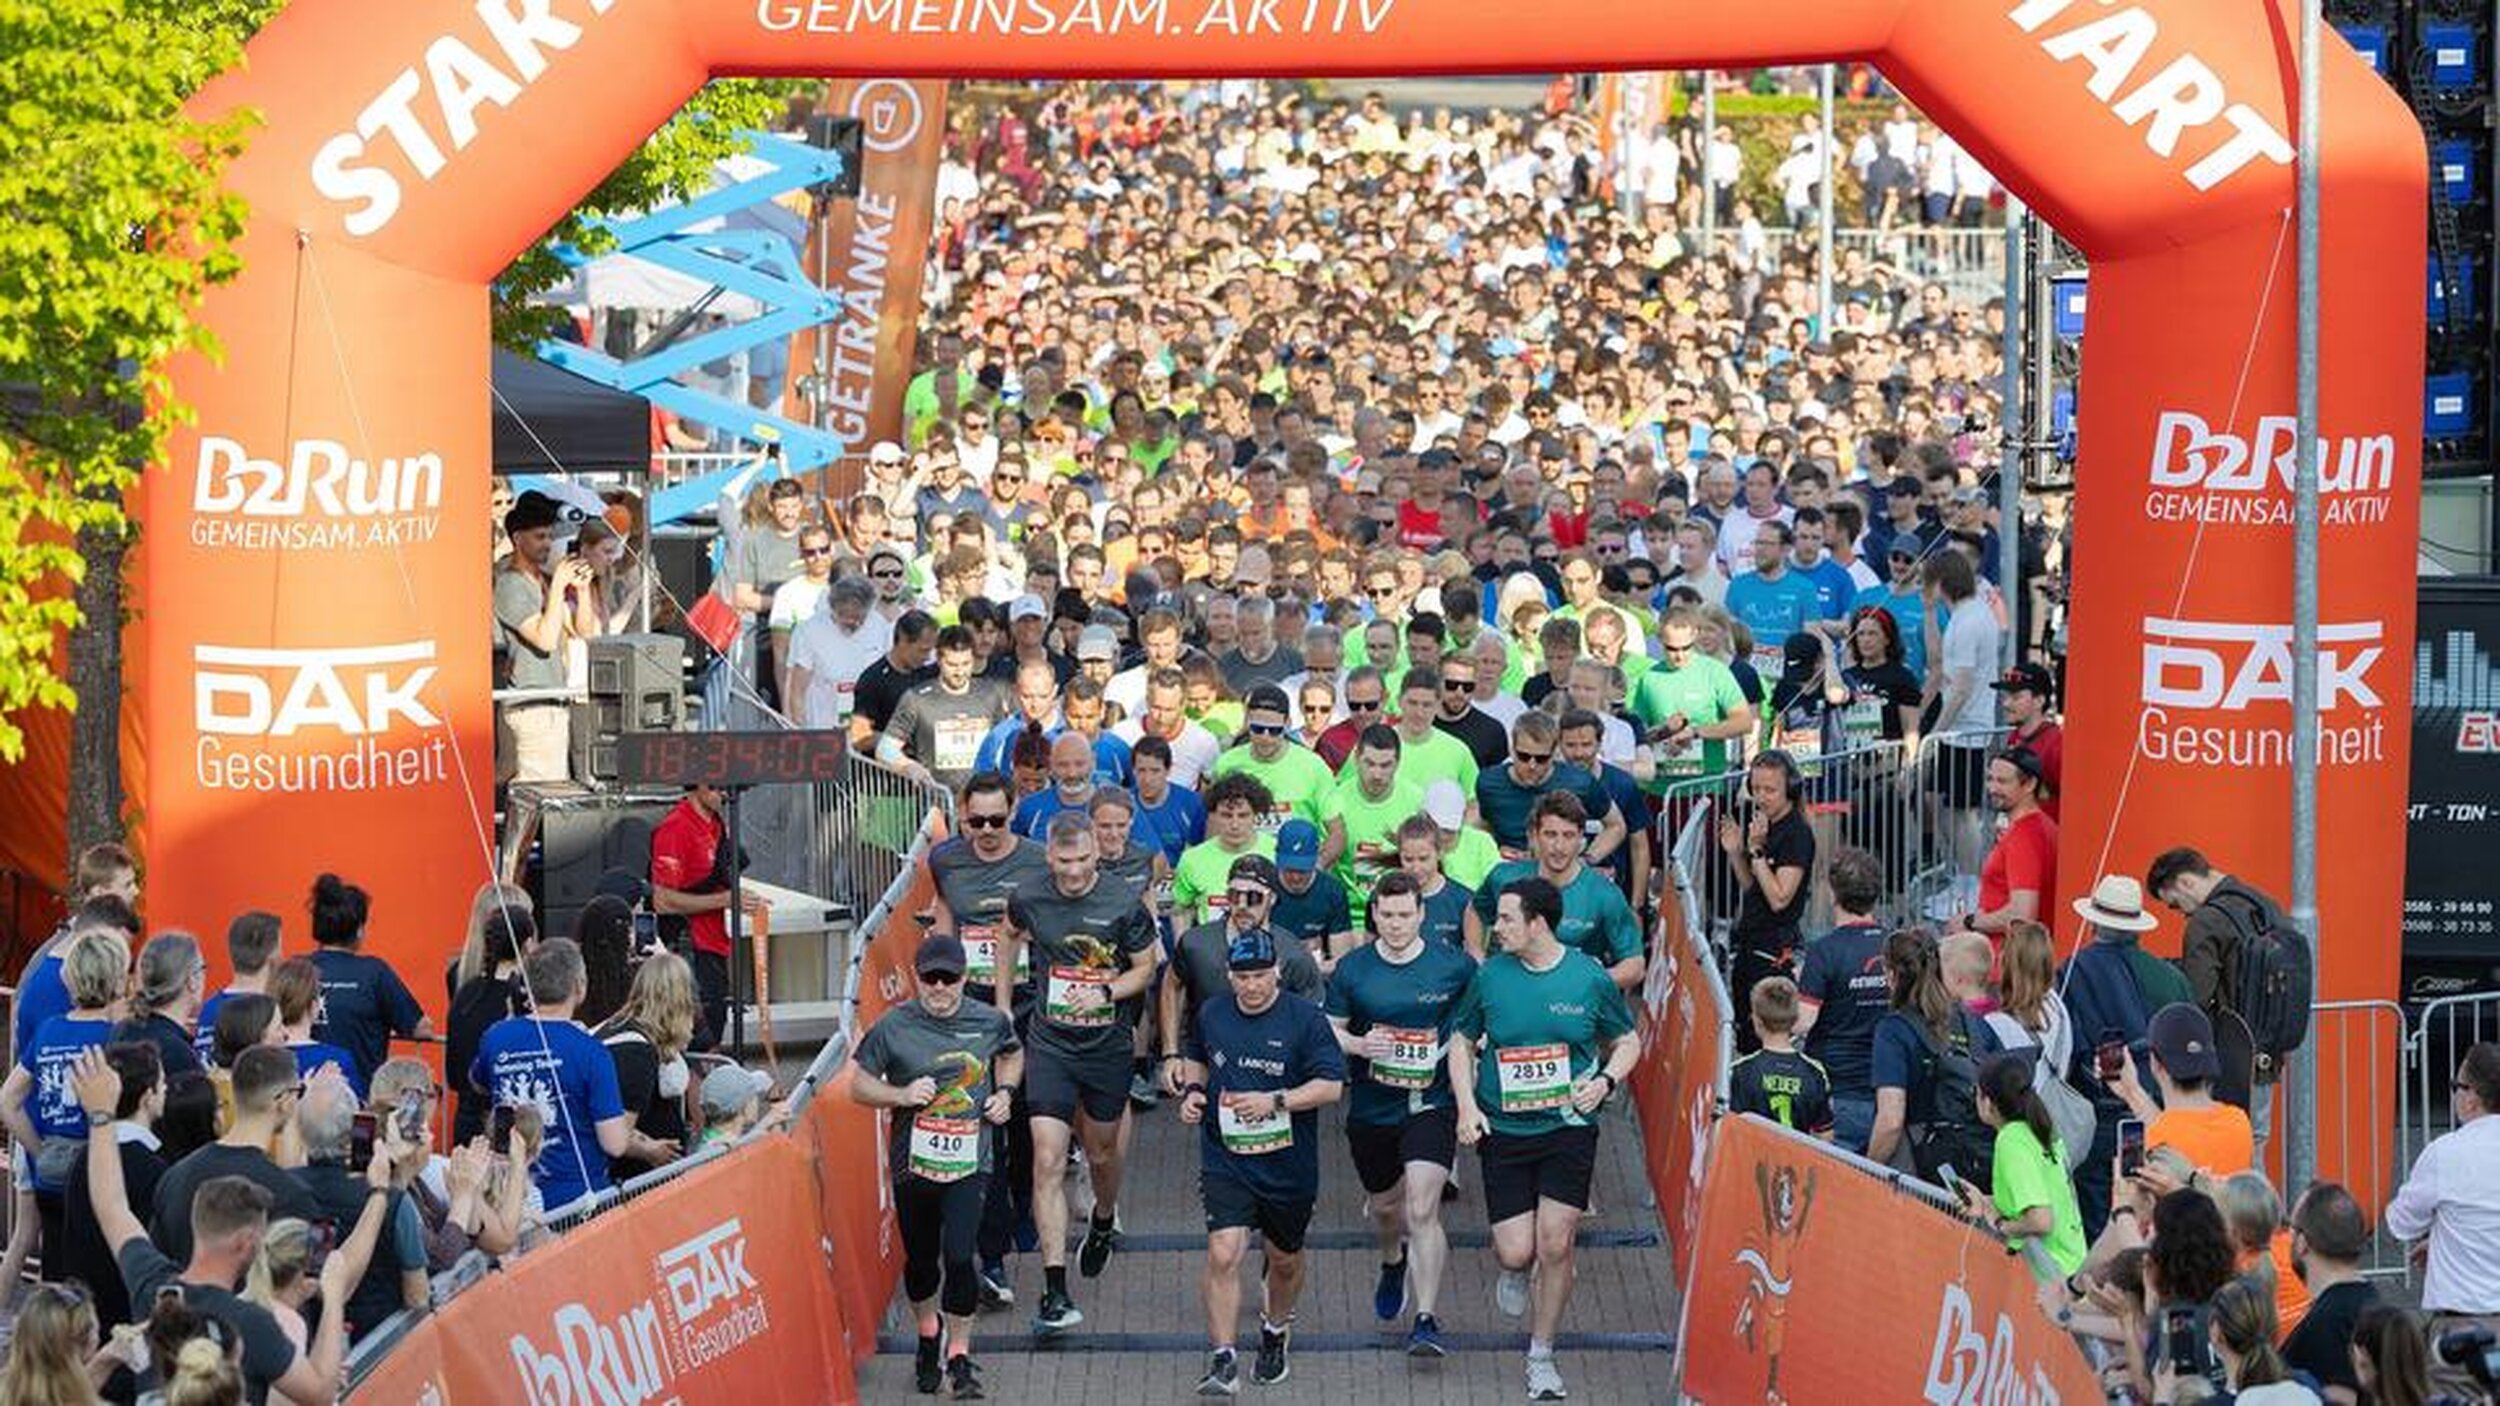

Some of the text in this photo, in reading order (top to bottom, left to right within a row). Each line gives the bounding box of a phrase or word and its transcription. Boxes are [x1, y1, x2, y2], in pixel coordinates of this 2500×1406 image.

[311, 0, 614, 236] STAR
[194, 437, 442, 516] B2Run
[191, 519, 440, 549] GEMEINSAM. AKTIV
[2323, 497, 2391, 525] AKTIV
[194, 640, 442, 736] DAK
[2142, 616, 2385, 710] DAK
[196, 735, 448, 792] Gesundheit
[642, 734, 839, 779] 18:34:02
[1394, 1043, 1429, 1060] 818
[1512, 1061, 1557, 1080] 2819
[929, 1134, 963, 1152] 410
[658, 1216, 759, 1325] DAK
